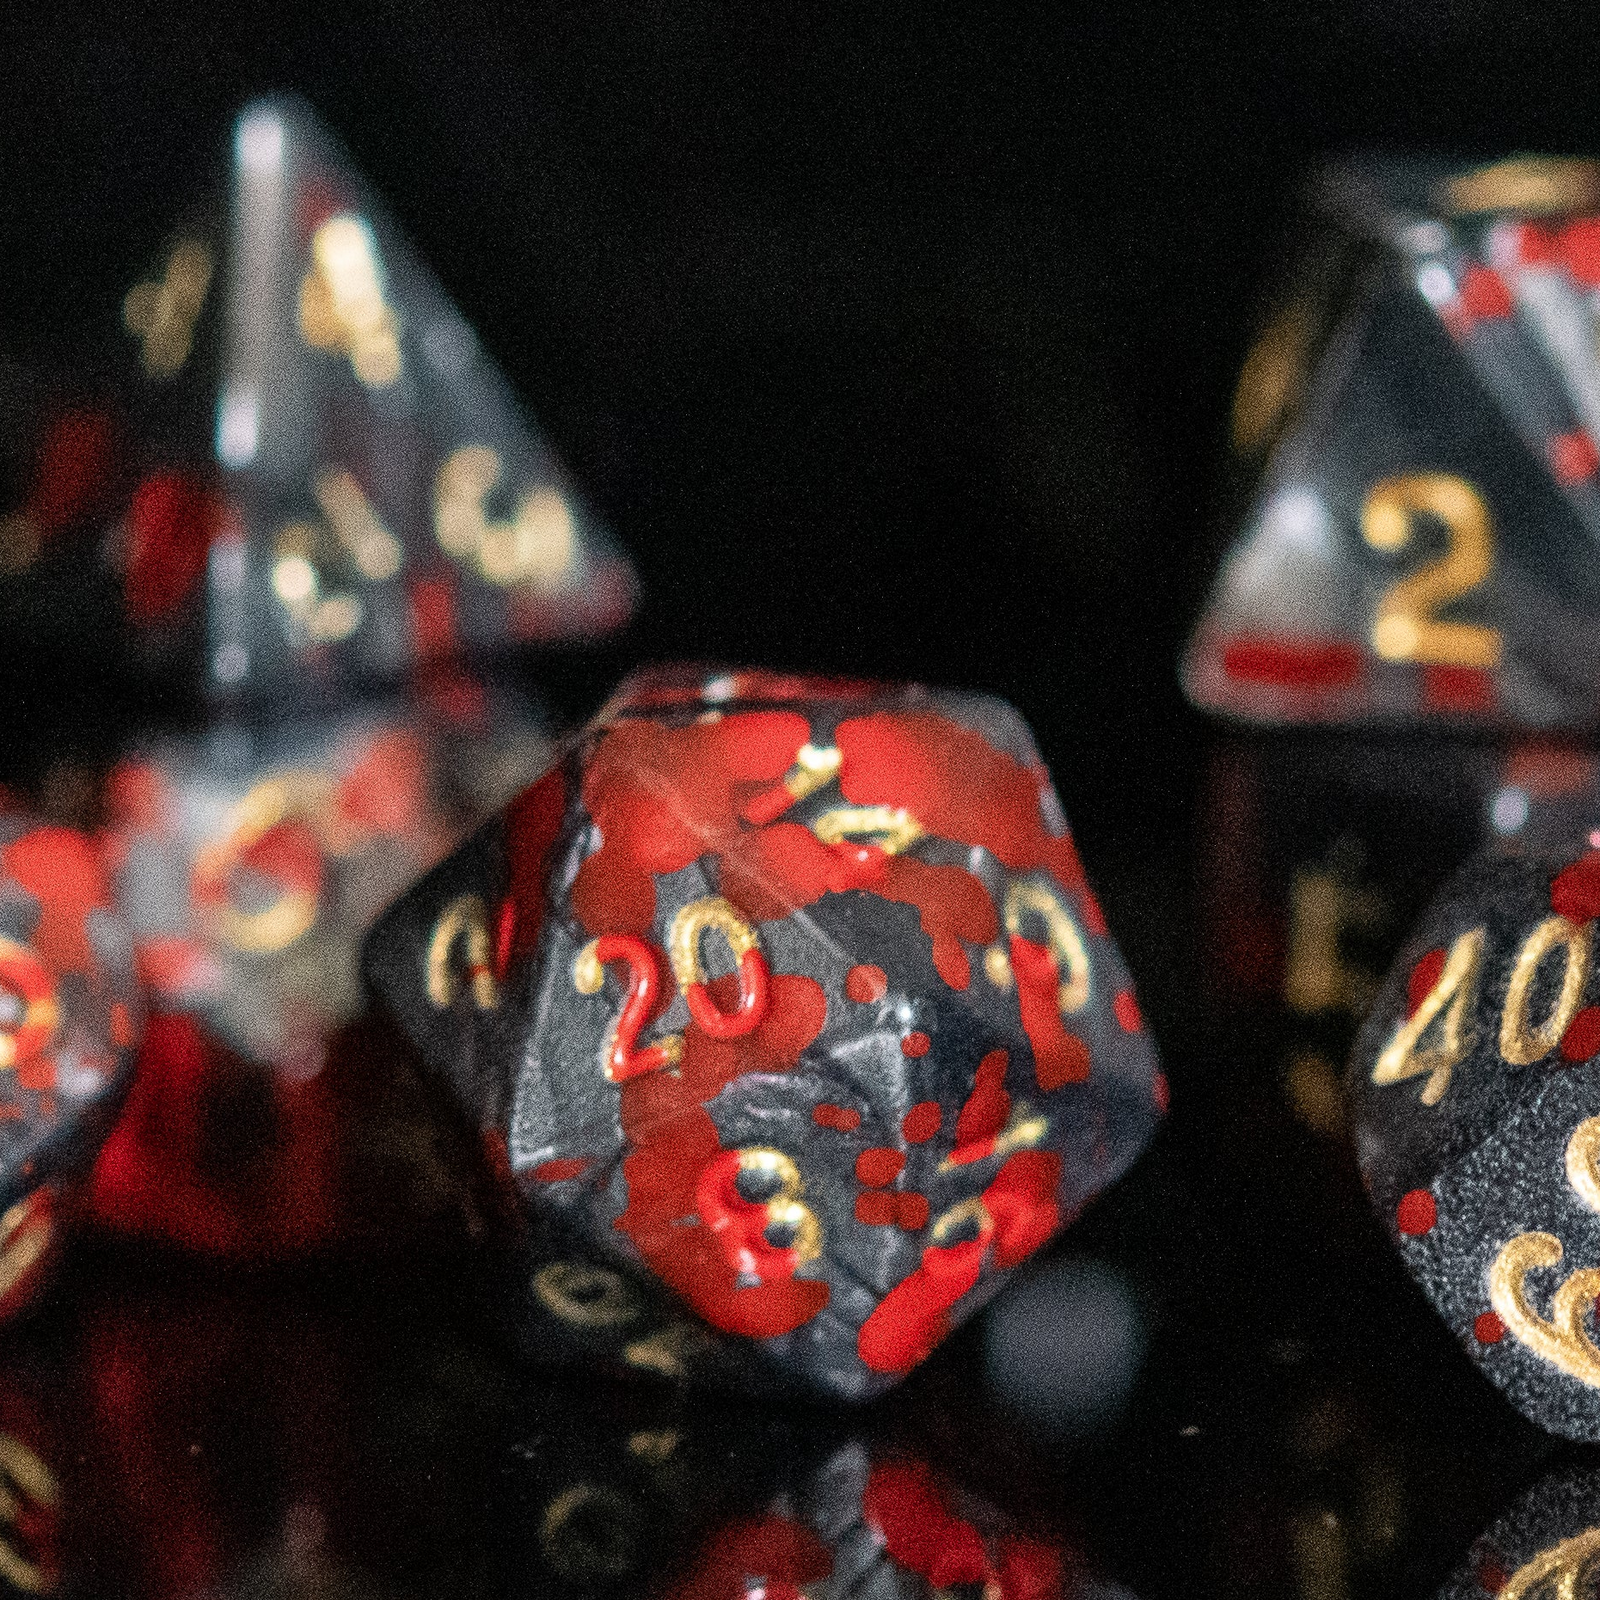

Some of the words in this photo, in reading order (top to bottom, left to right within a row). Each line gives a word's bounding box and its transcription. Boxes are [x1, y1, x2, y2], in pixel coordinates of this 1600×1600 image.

[1361, 472, 1504, 668] 2
[573, 894, 773, 1084] 20
[1370, 914, 1590, 1107] 40
[697, 1144, 825, 1282] 8
